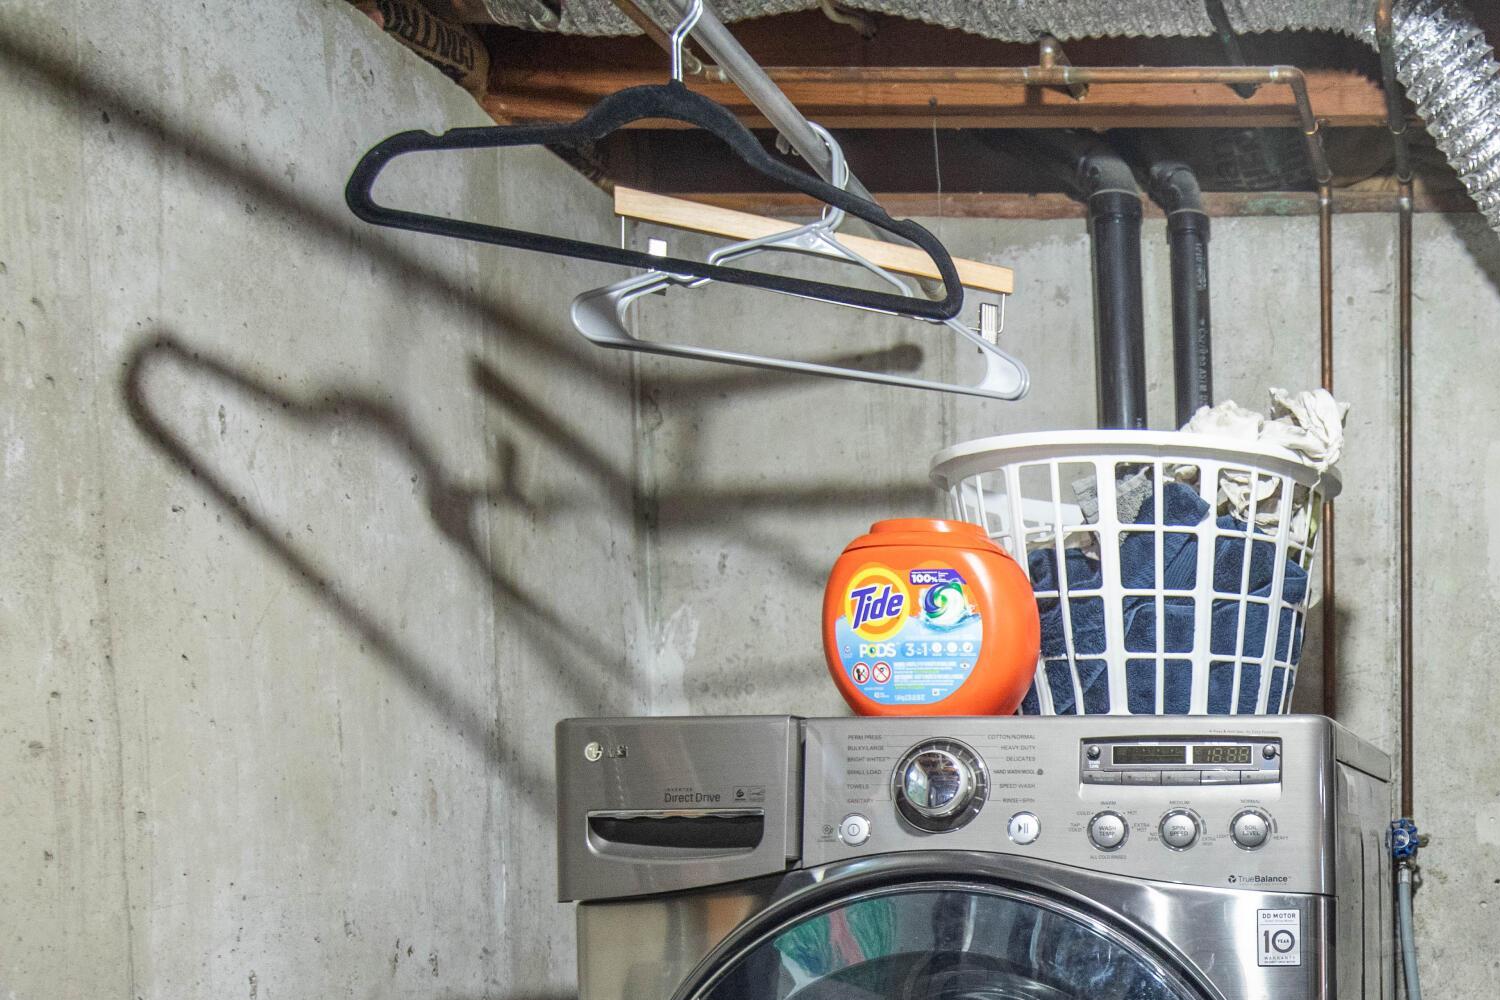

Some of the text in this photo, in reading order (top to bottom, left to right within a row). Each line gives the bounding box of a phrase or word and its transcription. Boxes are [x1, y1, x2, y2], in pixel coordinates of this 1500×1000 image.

[850, 583, 904, 629] Tide
[664, 793, 721, 803] Direct Drive
[1263, 929, 1295, 953] 10
